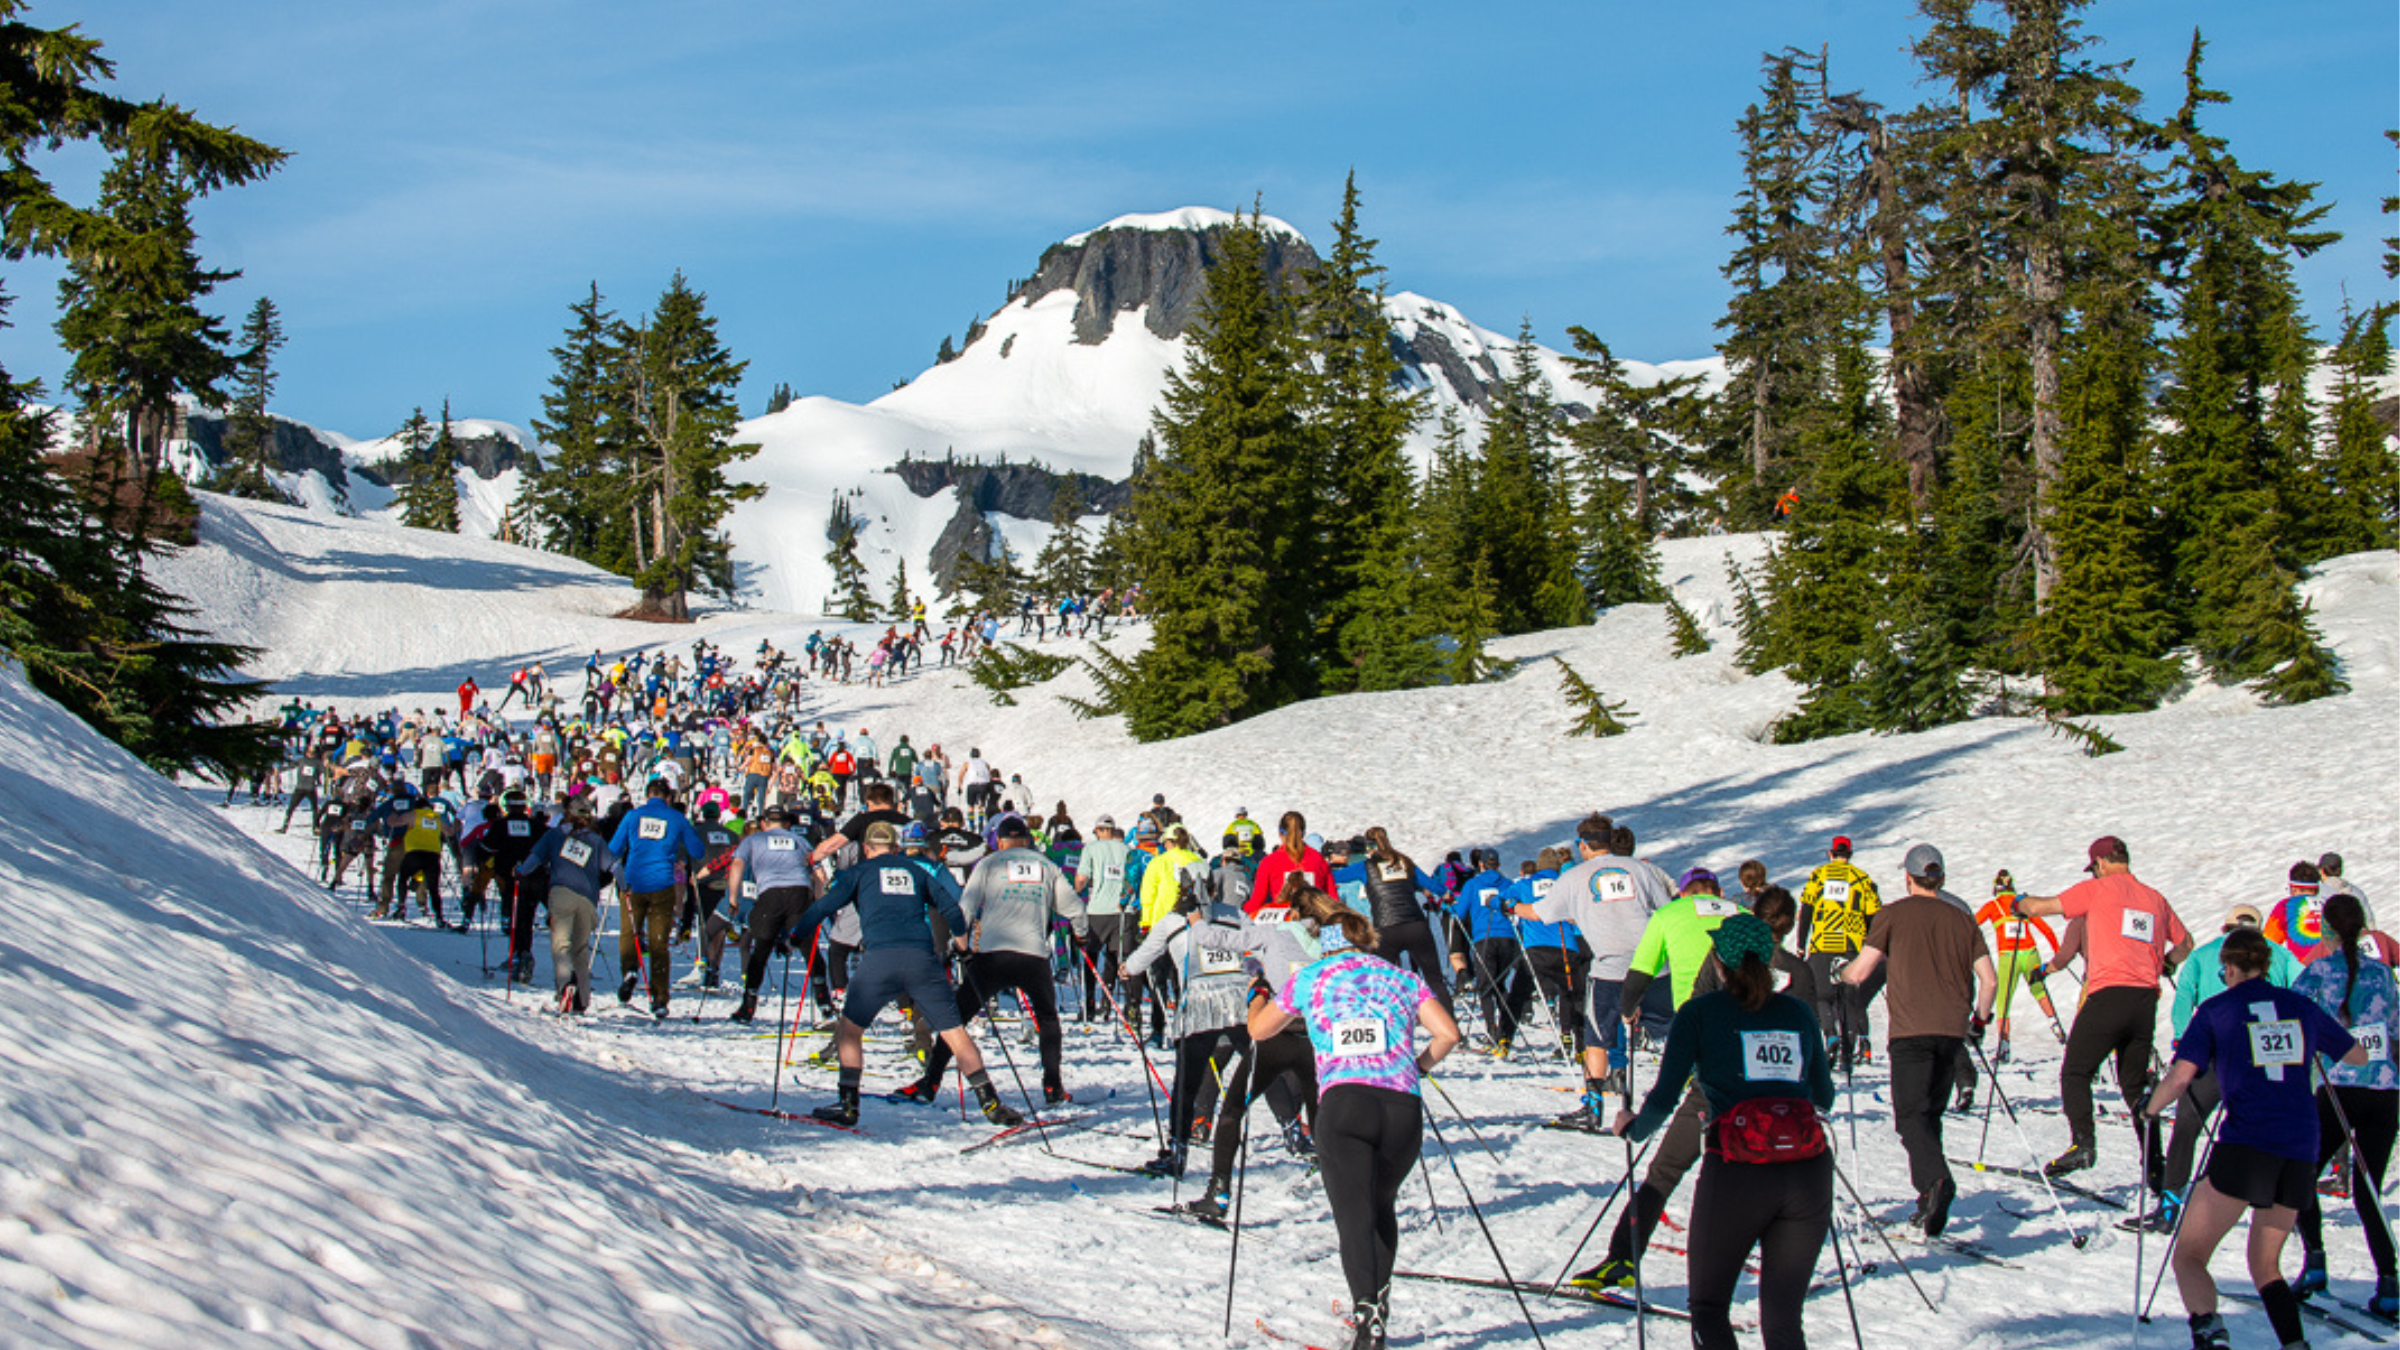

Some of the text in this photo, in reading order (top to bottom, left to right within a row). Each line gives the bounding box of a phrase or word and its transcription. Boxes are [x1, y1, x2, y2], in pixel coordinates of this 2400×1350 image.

[886, 876, 908, 887] 257
[1610, 880, 1626, 893] 16
[2132, 918, 2148, 932] 96
[1206, 950, 1233, 965] 293
[1340, 1028, 1377, 1046] 205
[2260, 1032, 2293, 1052] 321
[2359, 1034, 2382, 1050] 09
[1755, 1044, 1793, 1065] 402
